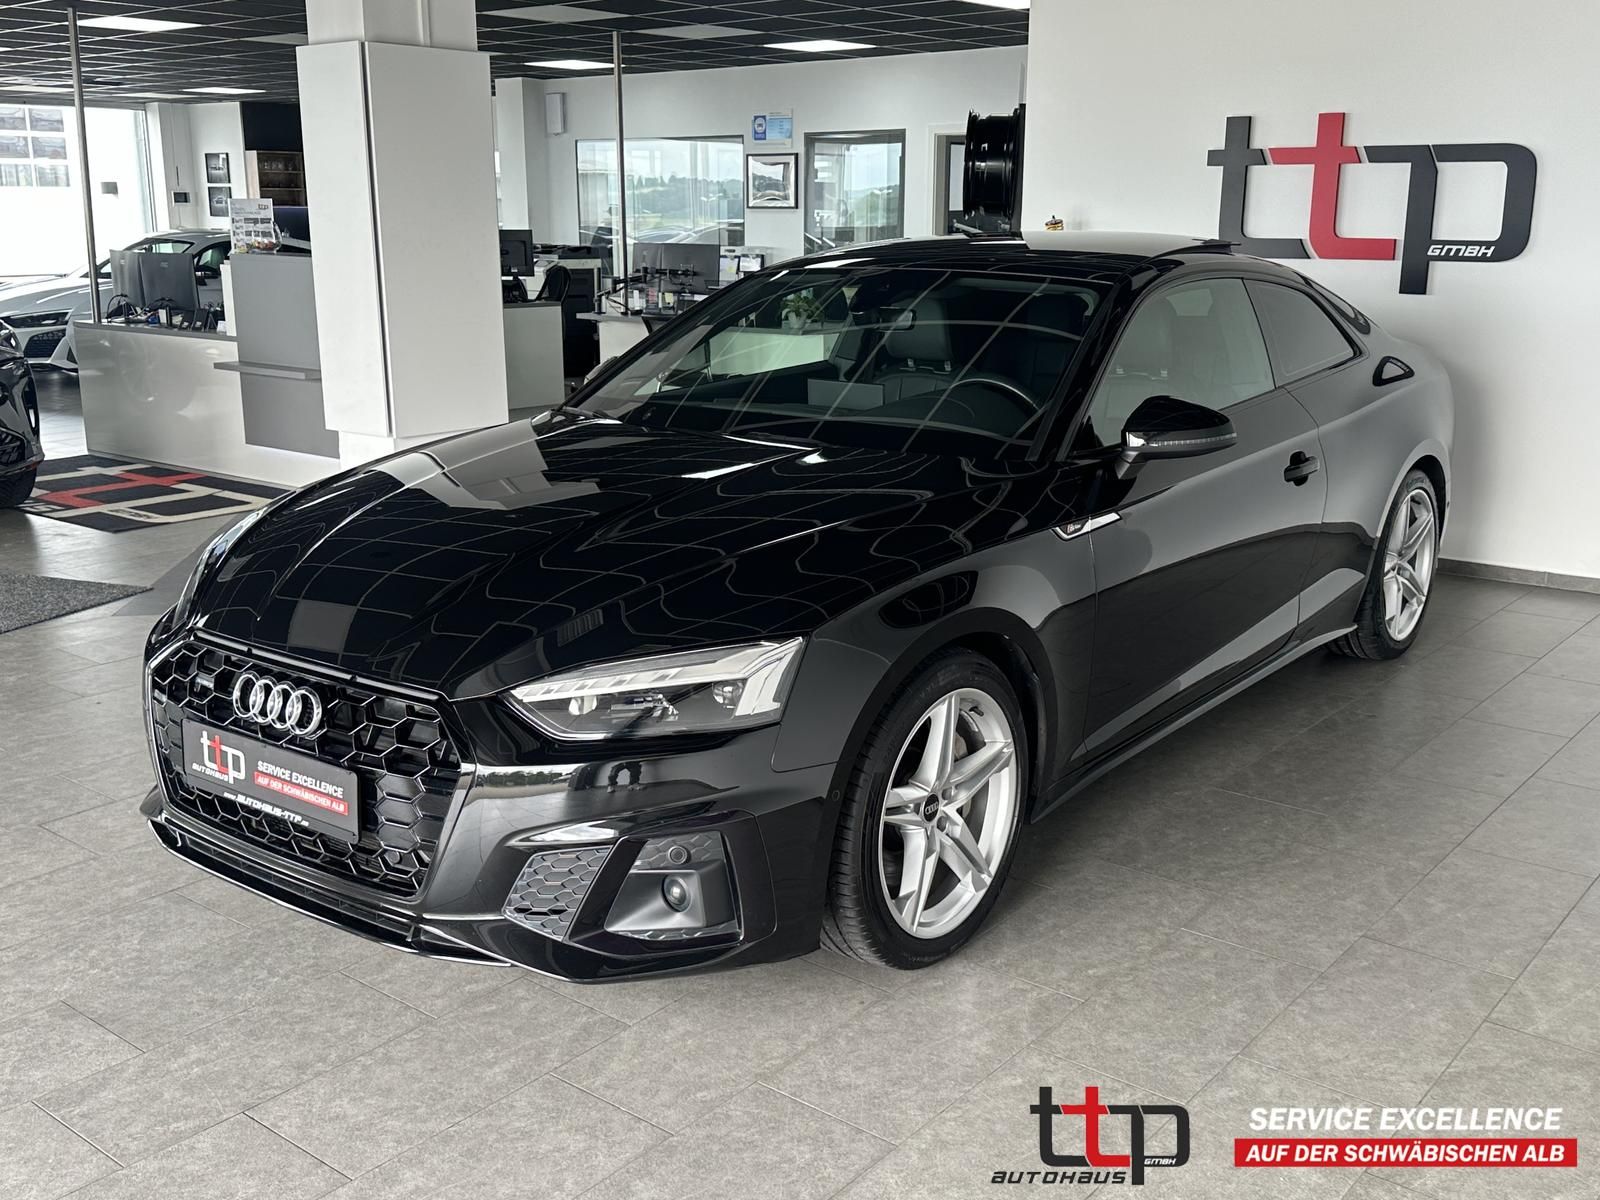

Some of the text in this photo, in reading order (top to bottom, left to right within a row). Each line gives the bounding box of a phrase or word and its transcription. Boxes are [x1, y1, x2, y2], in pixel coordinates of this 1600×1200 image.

[257, 760, 344, 799] SERVICE EXCELLENCE
[257, 774, 345, 812] AUF DER SCHWÄBISCHEN ALB
